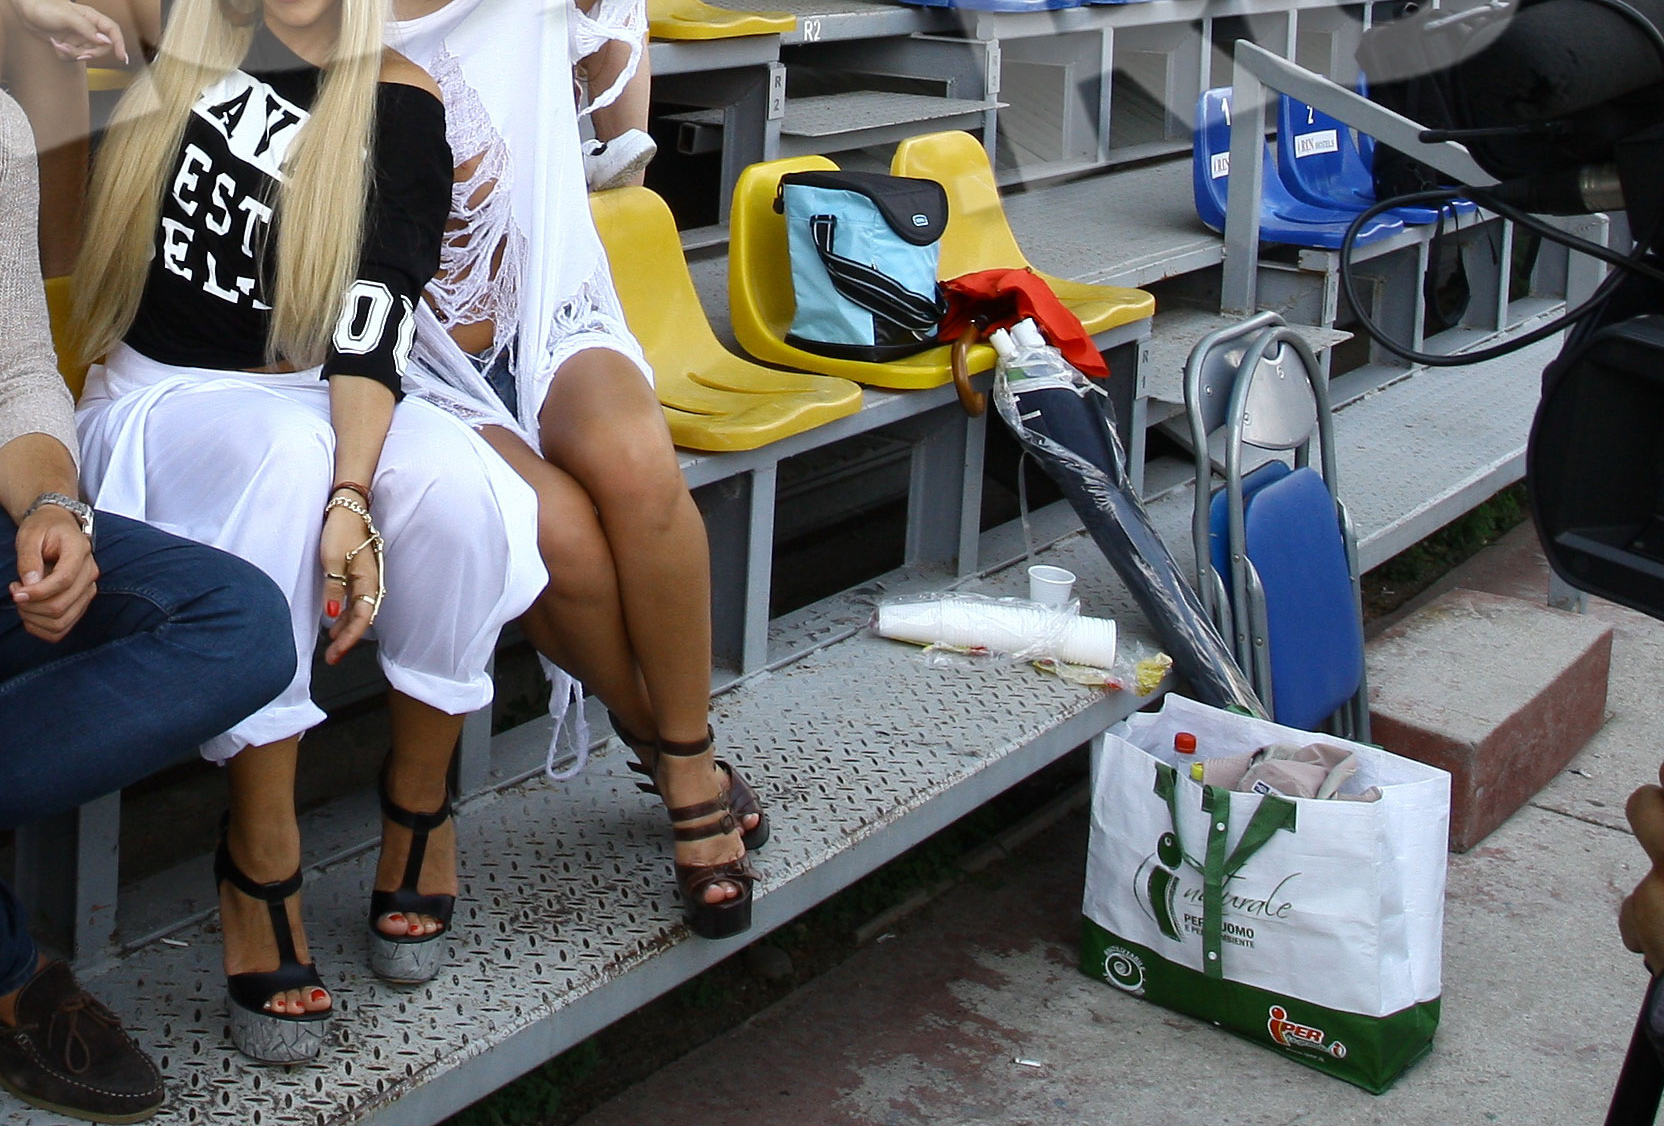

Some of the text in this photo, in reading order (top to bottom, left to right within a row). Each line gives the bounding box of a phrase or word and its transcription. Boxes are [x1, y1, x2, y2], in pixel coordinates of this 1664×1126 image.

[804, 19, 821, 41] R2
[775, 76, 782, 88] R
[774, 99, 780, 111] 2
[1221, 97, 1231, 126] 1
[1306, 105, 1314, 124] 2
